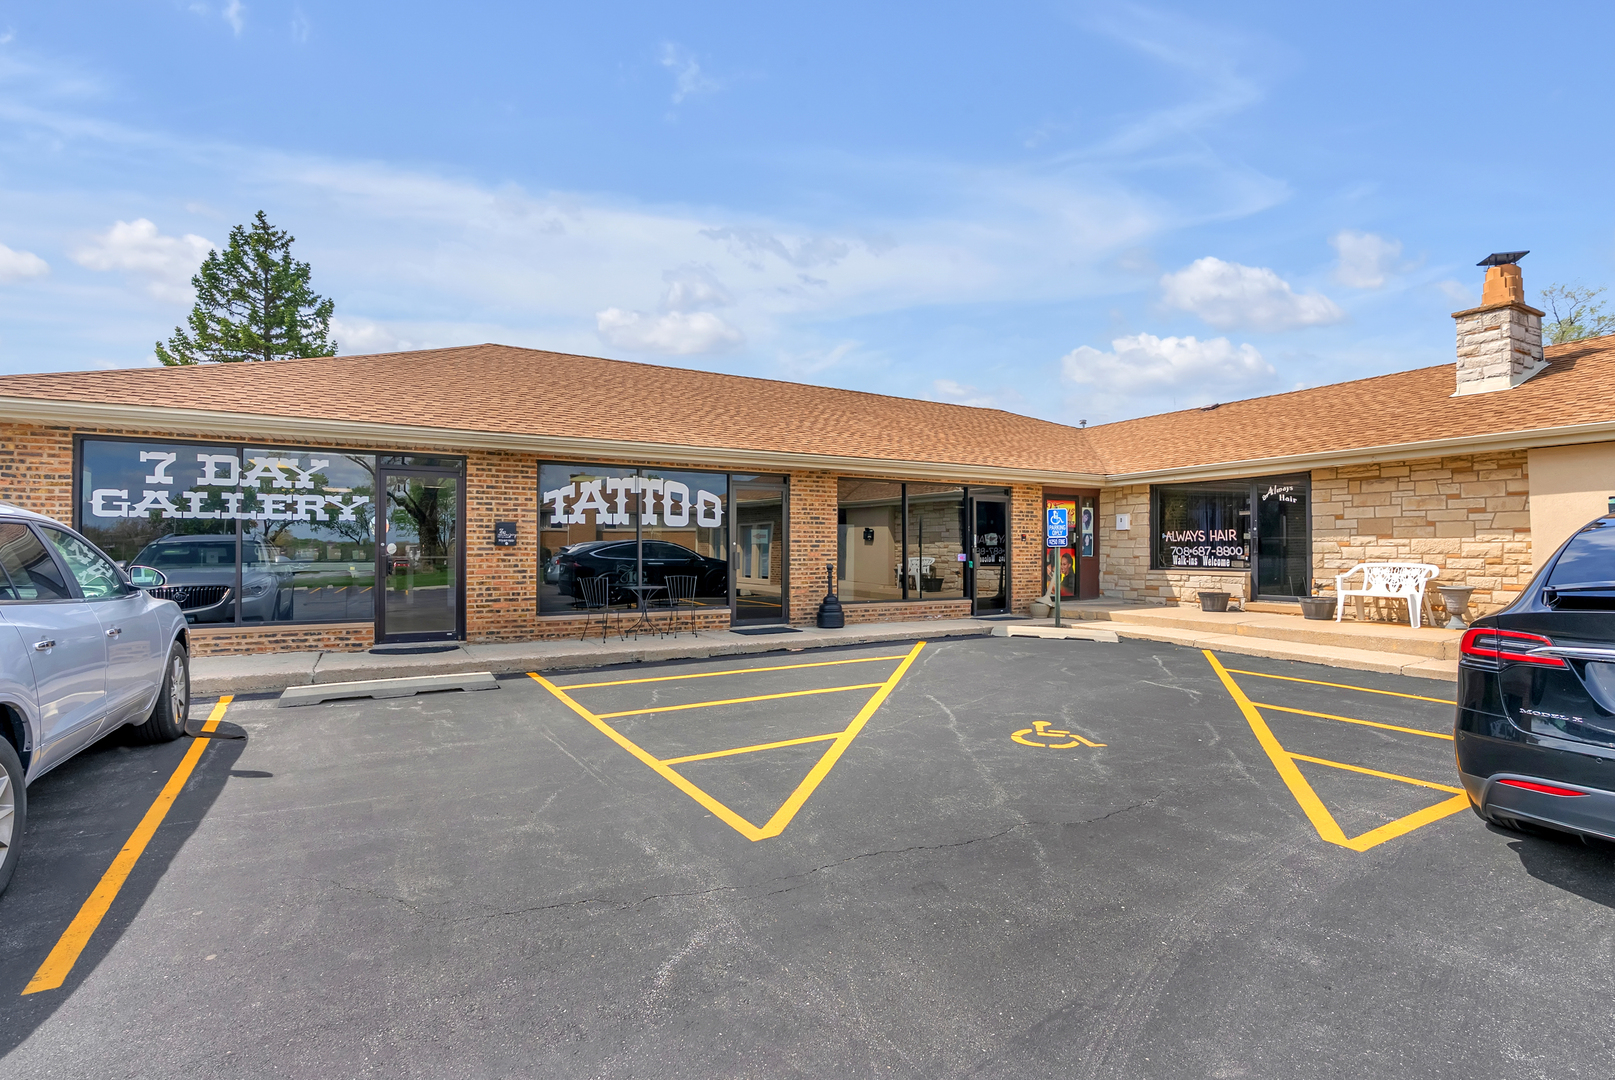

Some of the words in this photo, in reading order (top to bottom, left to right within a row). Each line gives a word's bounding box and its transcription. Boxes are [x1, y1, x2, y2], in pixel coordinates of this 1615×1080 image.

[140, 451, 177, 484] 7
[196, 453, 330, 489] DAY
[1266, 484, 1294, 496] Always
[88, 488, 370, 521] GALLERY
[543, 475, 726, 527] TATTOO
[1279, 493, 1298, 504] Hair
[1165, 530, 1206, 542] ALWAYS
[1209, 529, 1238, 542] HAIR
[1172, 555, 1198, 566] Walk-ins
[1202, 555, 1231, 567] Welcome
[1519, 707, 1570, 721] MODEL
